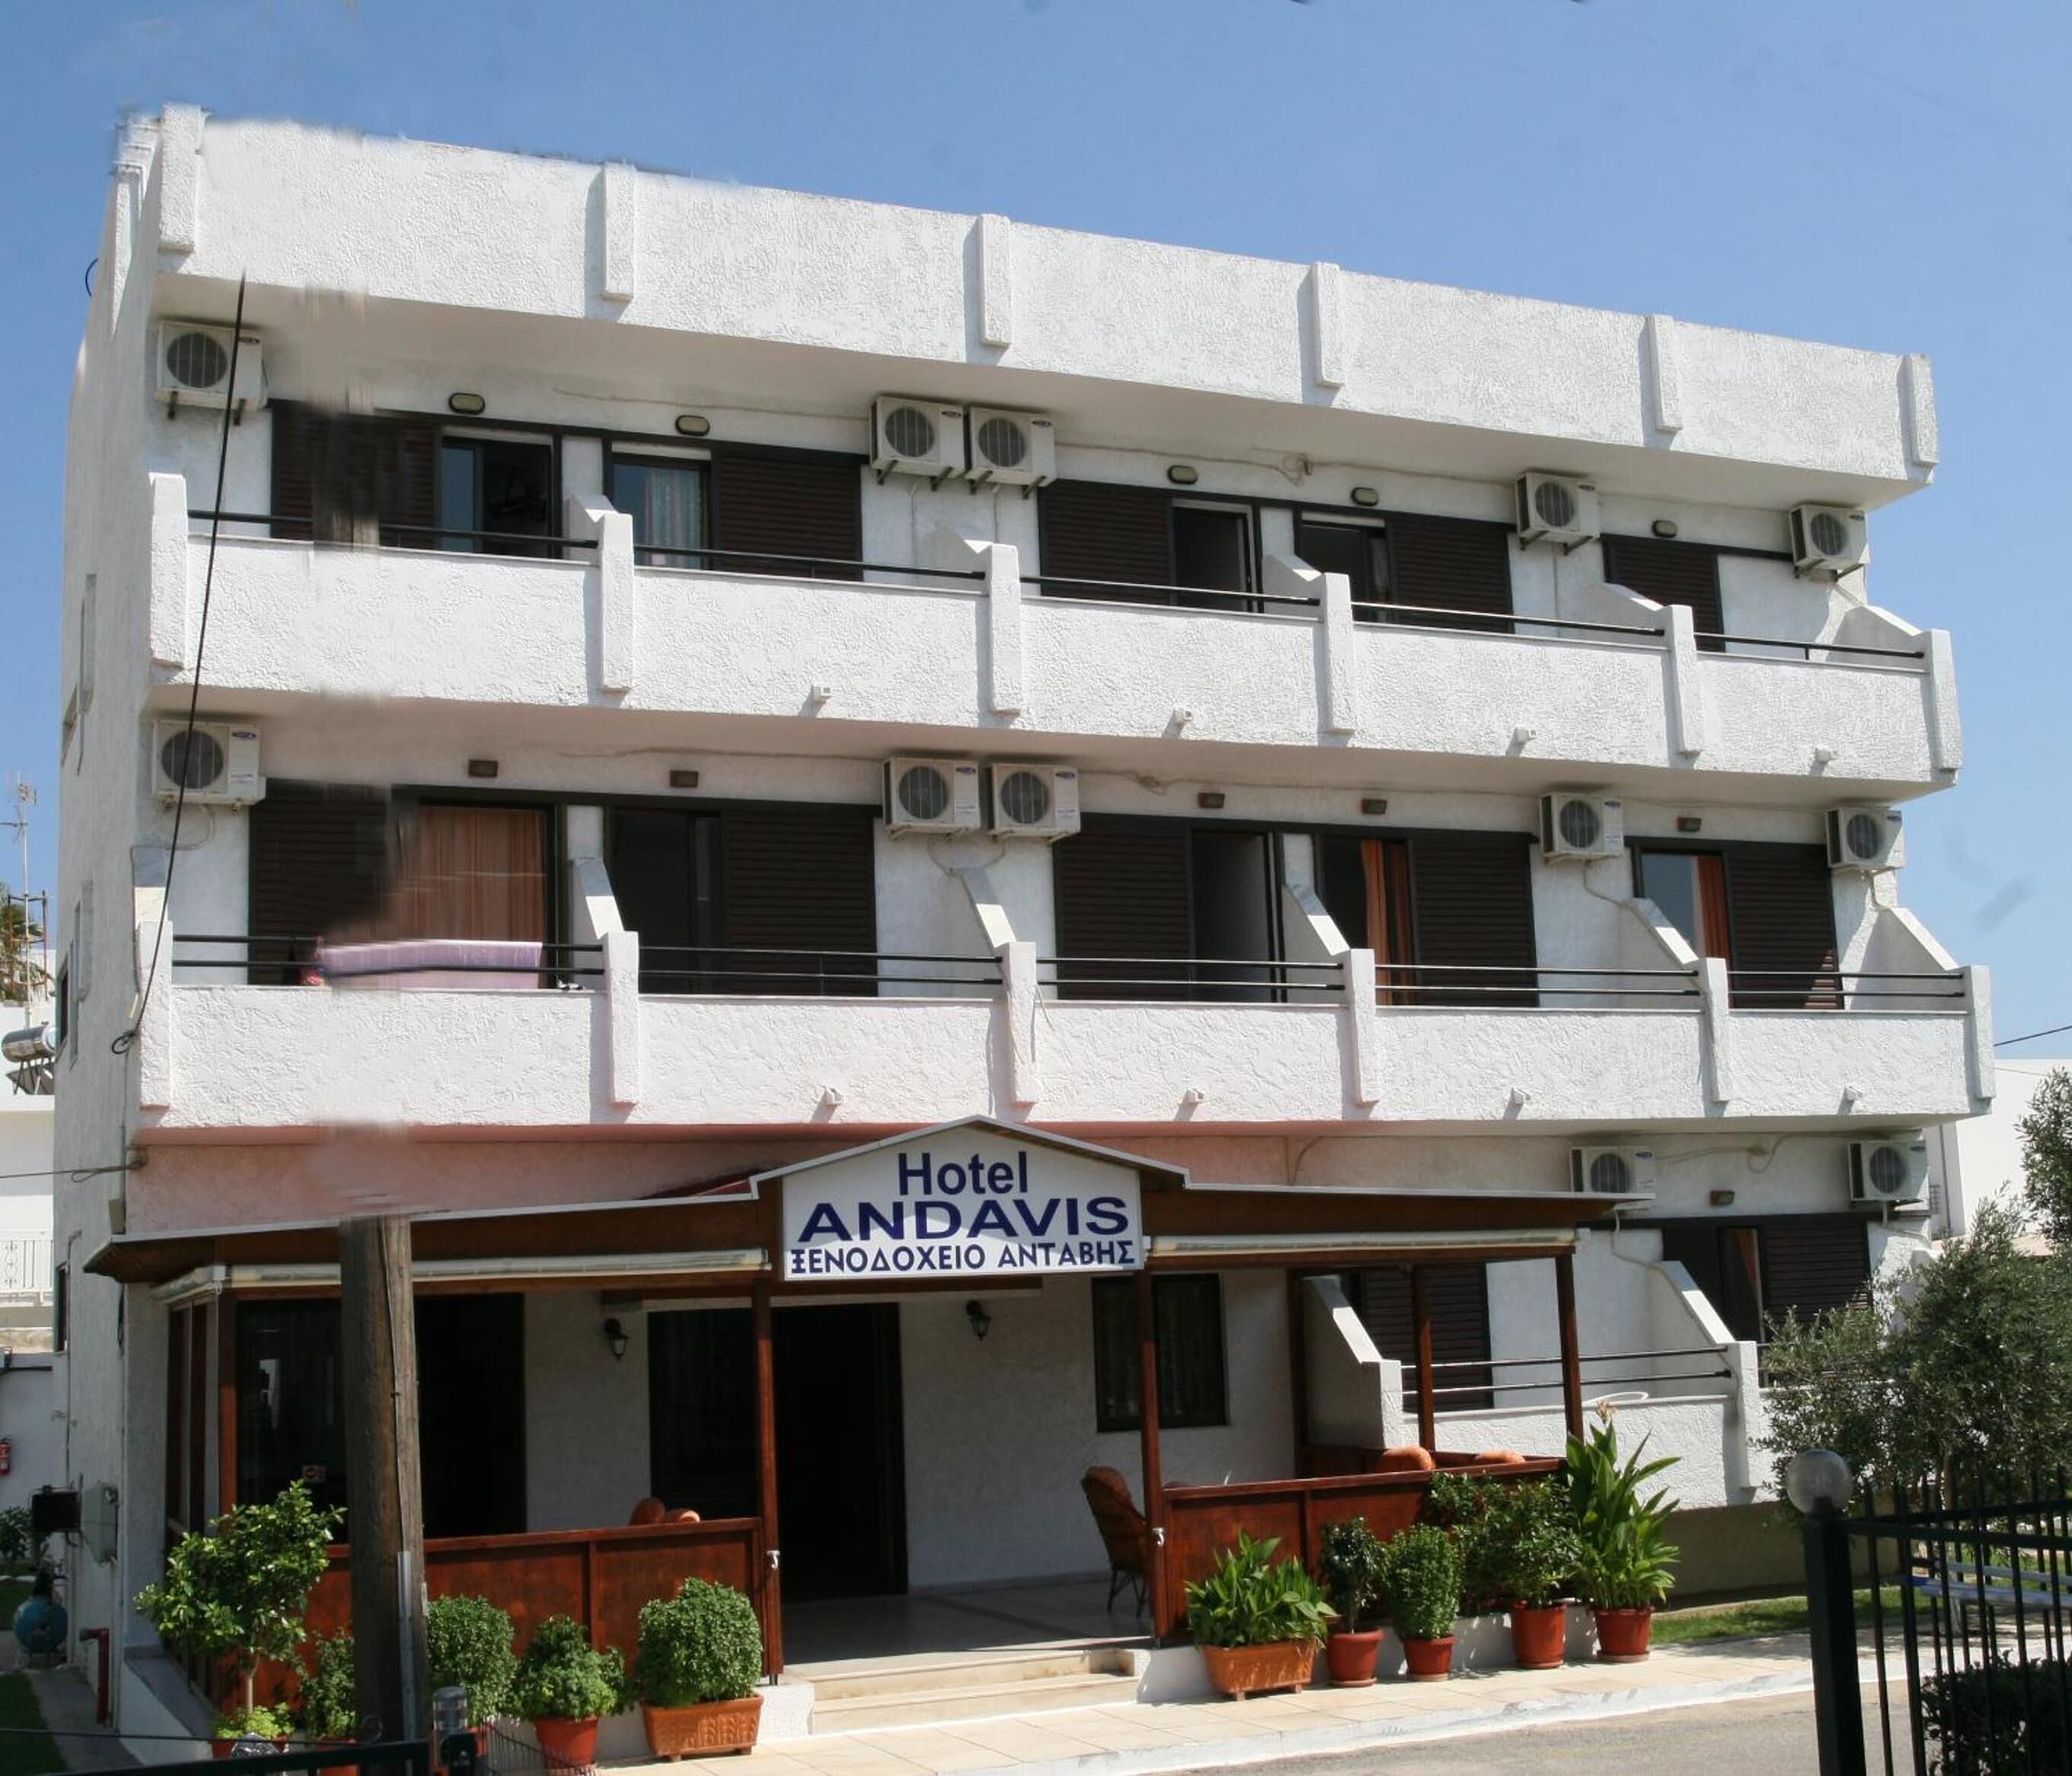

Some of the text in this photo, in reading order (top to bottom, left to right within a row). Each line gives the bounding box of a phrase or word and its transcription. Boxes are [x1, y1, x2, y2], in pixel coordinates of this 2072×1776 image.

[898, 1151, 1028, 1196] Hotel
[797, 1196, 1130, 1244] ANDAVIS
[790, 1240, 1136, 1274] ΞΕΝΟΔΟΧΕΙΟ ΑΝΤΑΒΗΣ
